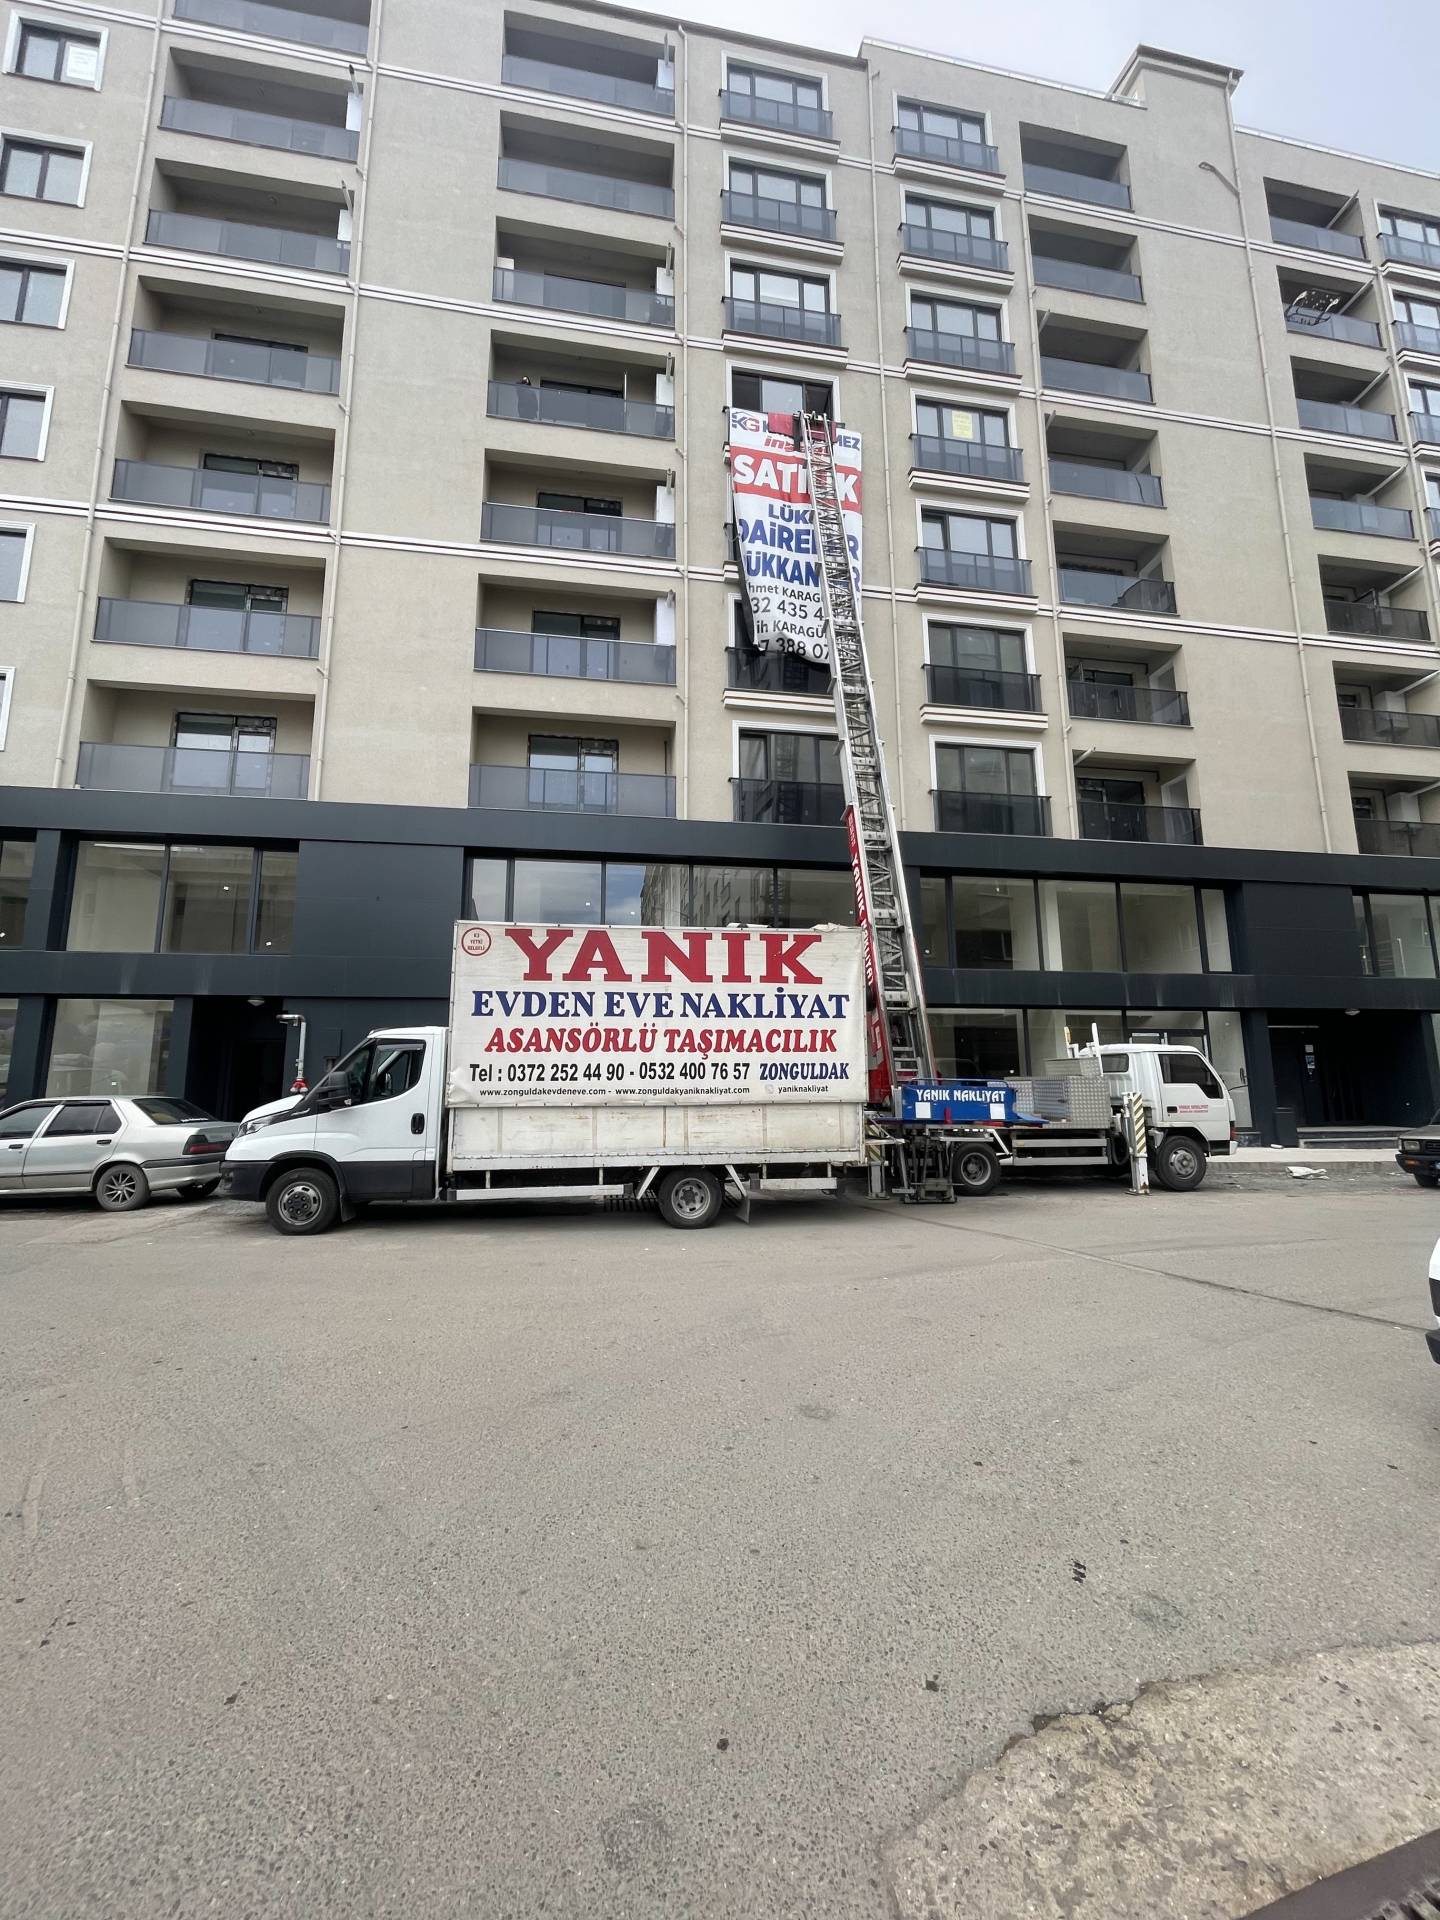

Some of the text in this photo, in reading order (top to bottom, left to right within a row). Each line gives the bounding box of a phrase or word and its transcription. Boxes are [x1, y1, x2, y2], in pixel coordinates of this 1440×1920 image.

[733, 454, 859, 504] SATIK
[768, 504, 815, 524] LÜK
[777, 599, 808, 620] 435
[776, 637, 806, 656] 388
[505, 929, 823, 984] YANIK
[471, 987, 850, 1019] EVDEN EVE NAKLİYAT
[484, 1022, 837, 1060] ASANSÖRLÜ TAŞIMACILIK
[470, 1064, 492, 1082] Tel
[507, 1063, 546, 1082] 0372
[550, 1063, 579, 1082] 252
[583, 1063, 602, 1081] 44
[606, 1063, 625, 1081] 90
[639, 1062, 675, 1080] 0532
[679, 1062, 706, 1080] 400
[711, 1062, 729, 1080] 76
[733, 1062, 751, 1080] 57
[759, 1062, 850, 1081] ZONGULDAK
[479, 1086, 606, 1097] www.zonguldakevdeneve.com
[615, 1086, 750, 1096] www.zonguldakyaniknakliyat.com
[778, 1084, 829, 1094] yaniknakliyat
[917, 1089, 950, 1101] YANIK
